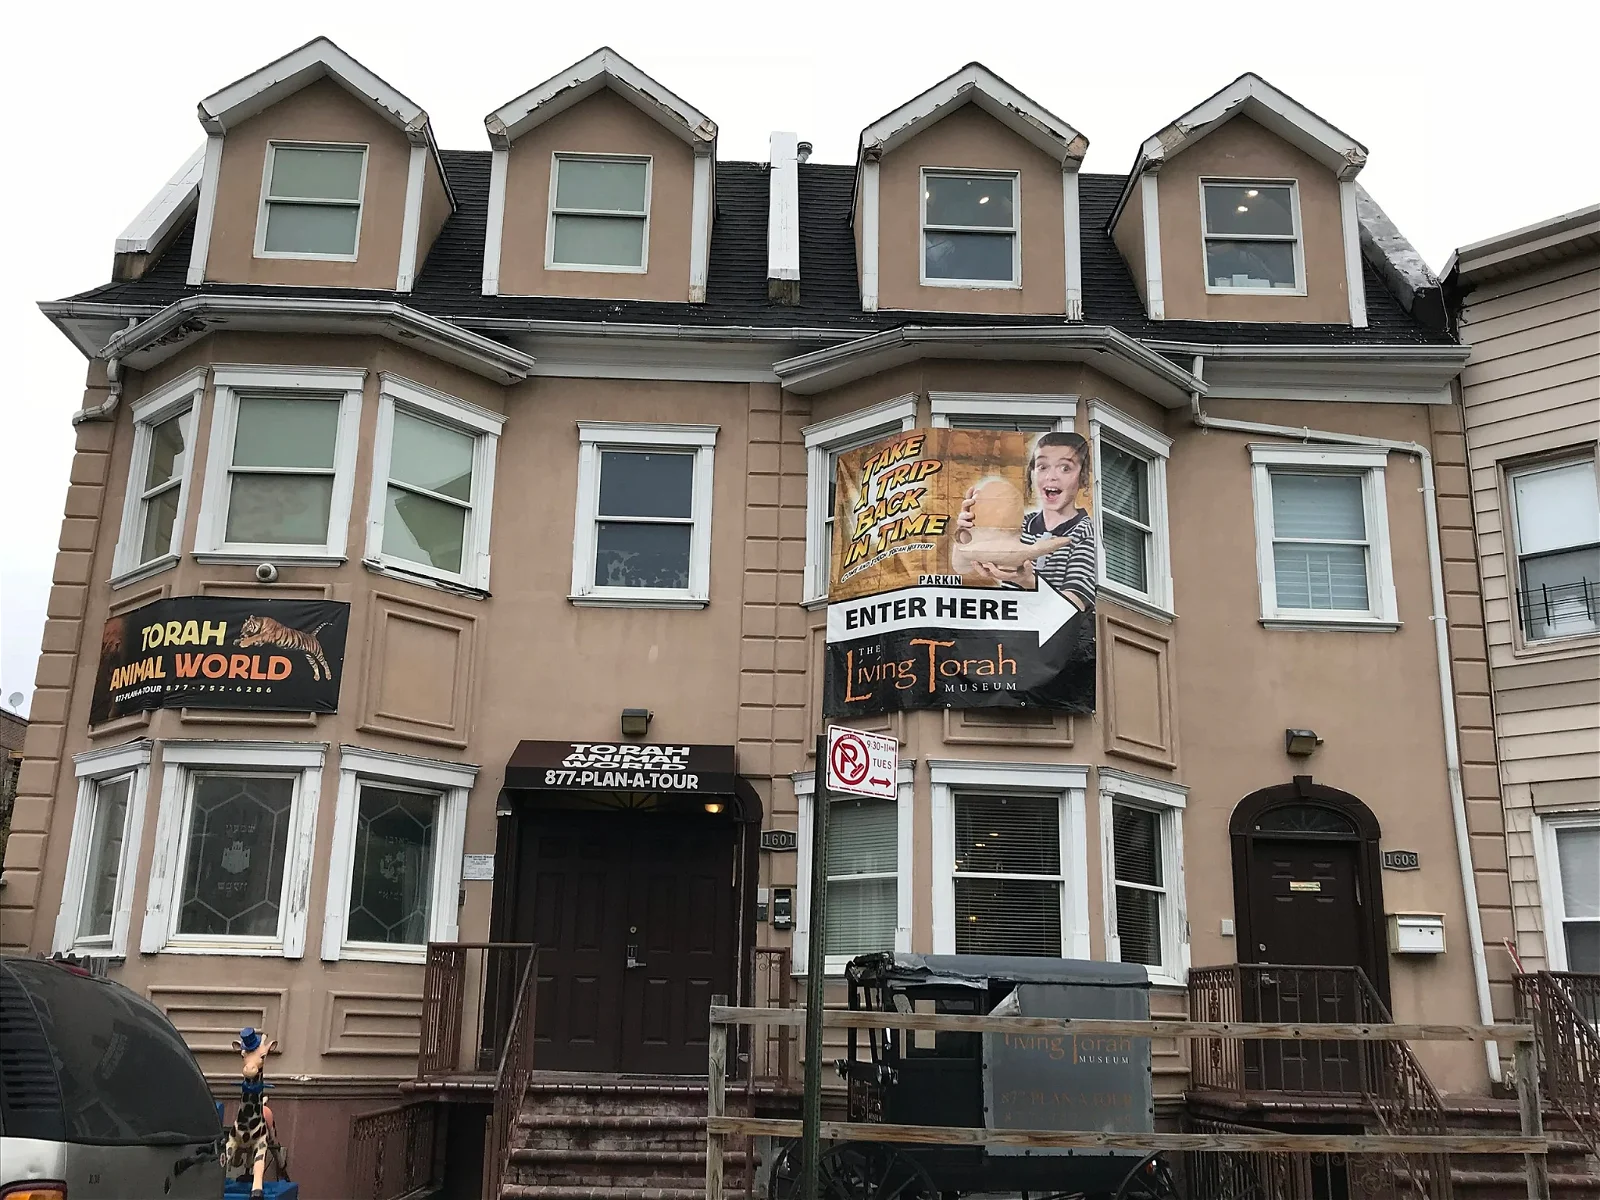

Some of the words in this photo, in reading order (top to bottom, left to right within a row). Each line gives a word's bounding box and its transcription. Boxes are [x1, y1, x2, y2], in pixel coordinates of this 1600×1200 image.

[863, 435, 926, 485] TAKE
[854, 484, 869, 513] A
[876, 459, 943, 501] TRIP
[853, 488, 928, 541] BACK
[844, 534, 871, 569] IN
[877, 514, 950, 553] TIME
[907, 543, 935, 552] HISTORY
[845, 597, 927, 631] ENTER
[936, 597, 1018, 620] HERE
[142, 620, 227, 652] TORAH
[858, 644, 881, 656] THE
[109, 655, 167, 691] ANIMAL
[175, 653, 292, 681] WORLD
[844, 649, 917, 703] Living
[910, 638, 1017, 694] Torah
[945, 682, 1017, 693] MUSEUM
[571, 744, 690, 756] TORAH
[564, 753, 689, 764] ANIMAL
[873, 758, 892, 770] TUES
[561, 760, 687, 771] WORLD
[544, 770, 699, 790] 877-PLAN-A-TOUR
[764, 834, 794, 846] 1601
[1386, 854, 1417, 866] 1603
[1079, 1055, 1130, 1064] MUSEUM
